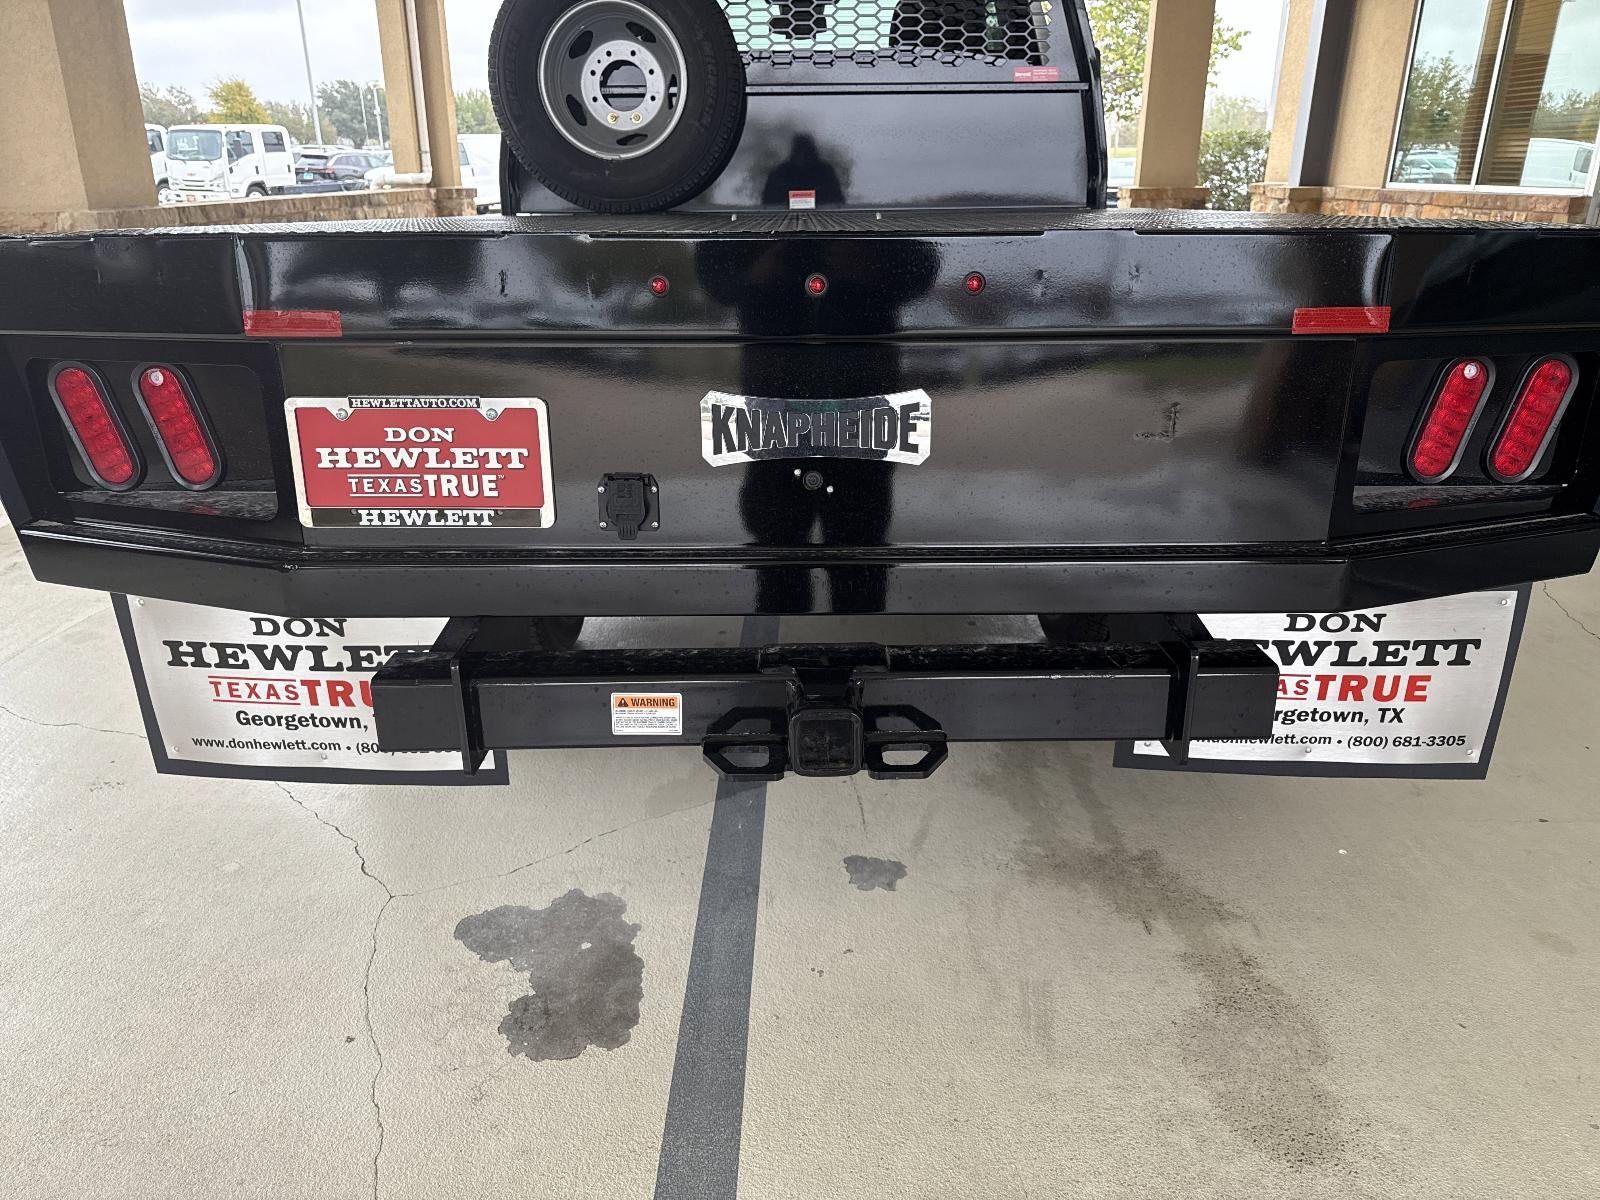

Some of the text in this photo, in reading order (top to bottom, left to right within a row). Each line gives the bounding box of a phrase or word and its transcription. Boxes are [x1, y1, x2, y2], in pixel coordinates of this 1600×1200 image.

[351, 398, 478, 408] HEWLETTAUTO.COM
[383, 427, 455, 443] DON
[711, 401, 921, 456] KNAPHEIDE
[315, 447, 529, 469] HEWLETT
[357, 509, 495, 526] HEWLETT
[249, 617, 348, 638] DON
[1283, 613, 1387, 633] DON
[162, 639, 433, 673] HEWLE
[1256, 639, 1482, 667] WLETT
[630, 698, 675, 707] WARNING
[235, 709, 368, 732] Georgetown,
[1377, 707, 1406, 724] TX
[191, 736, 342, 752] www.donhewlett.com
[1347, 735, 1388, 749] (800)
[1392, 734, 1467, 748] 681-3305
